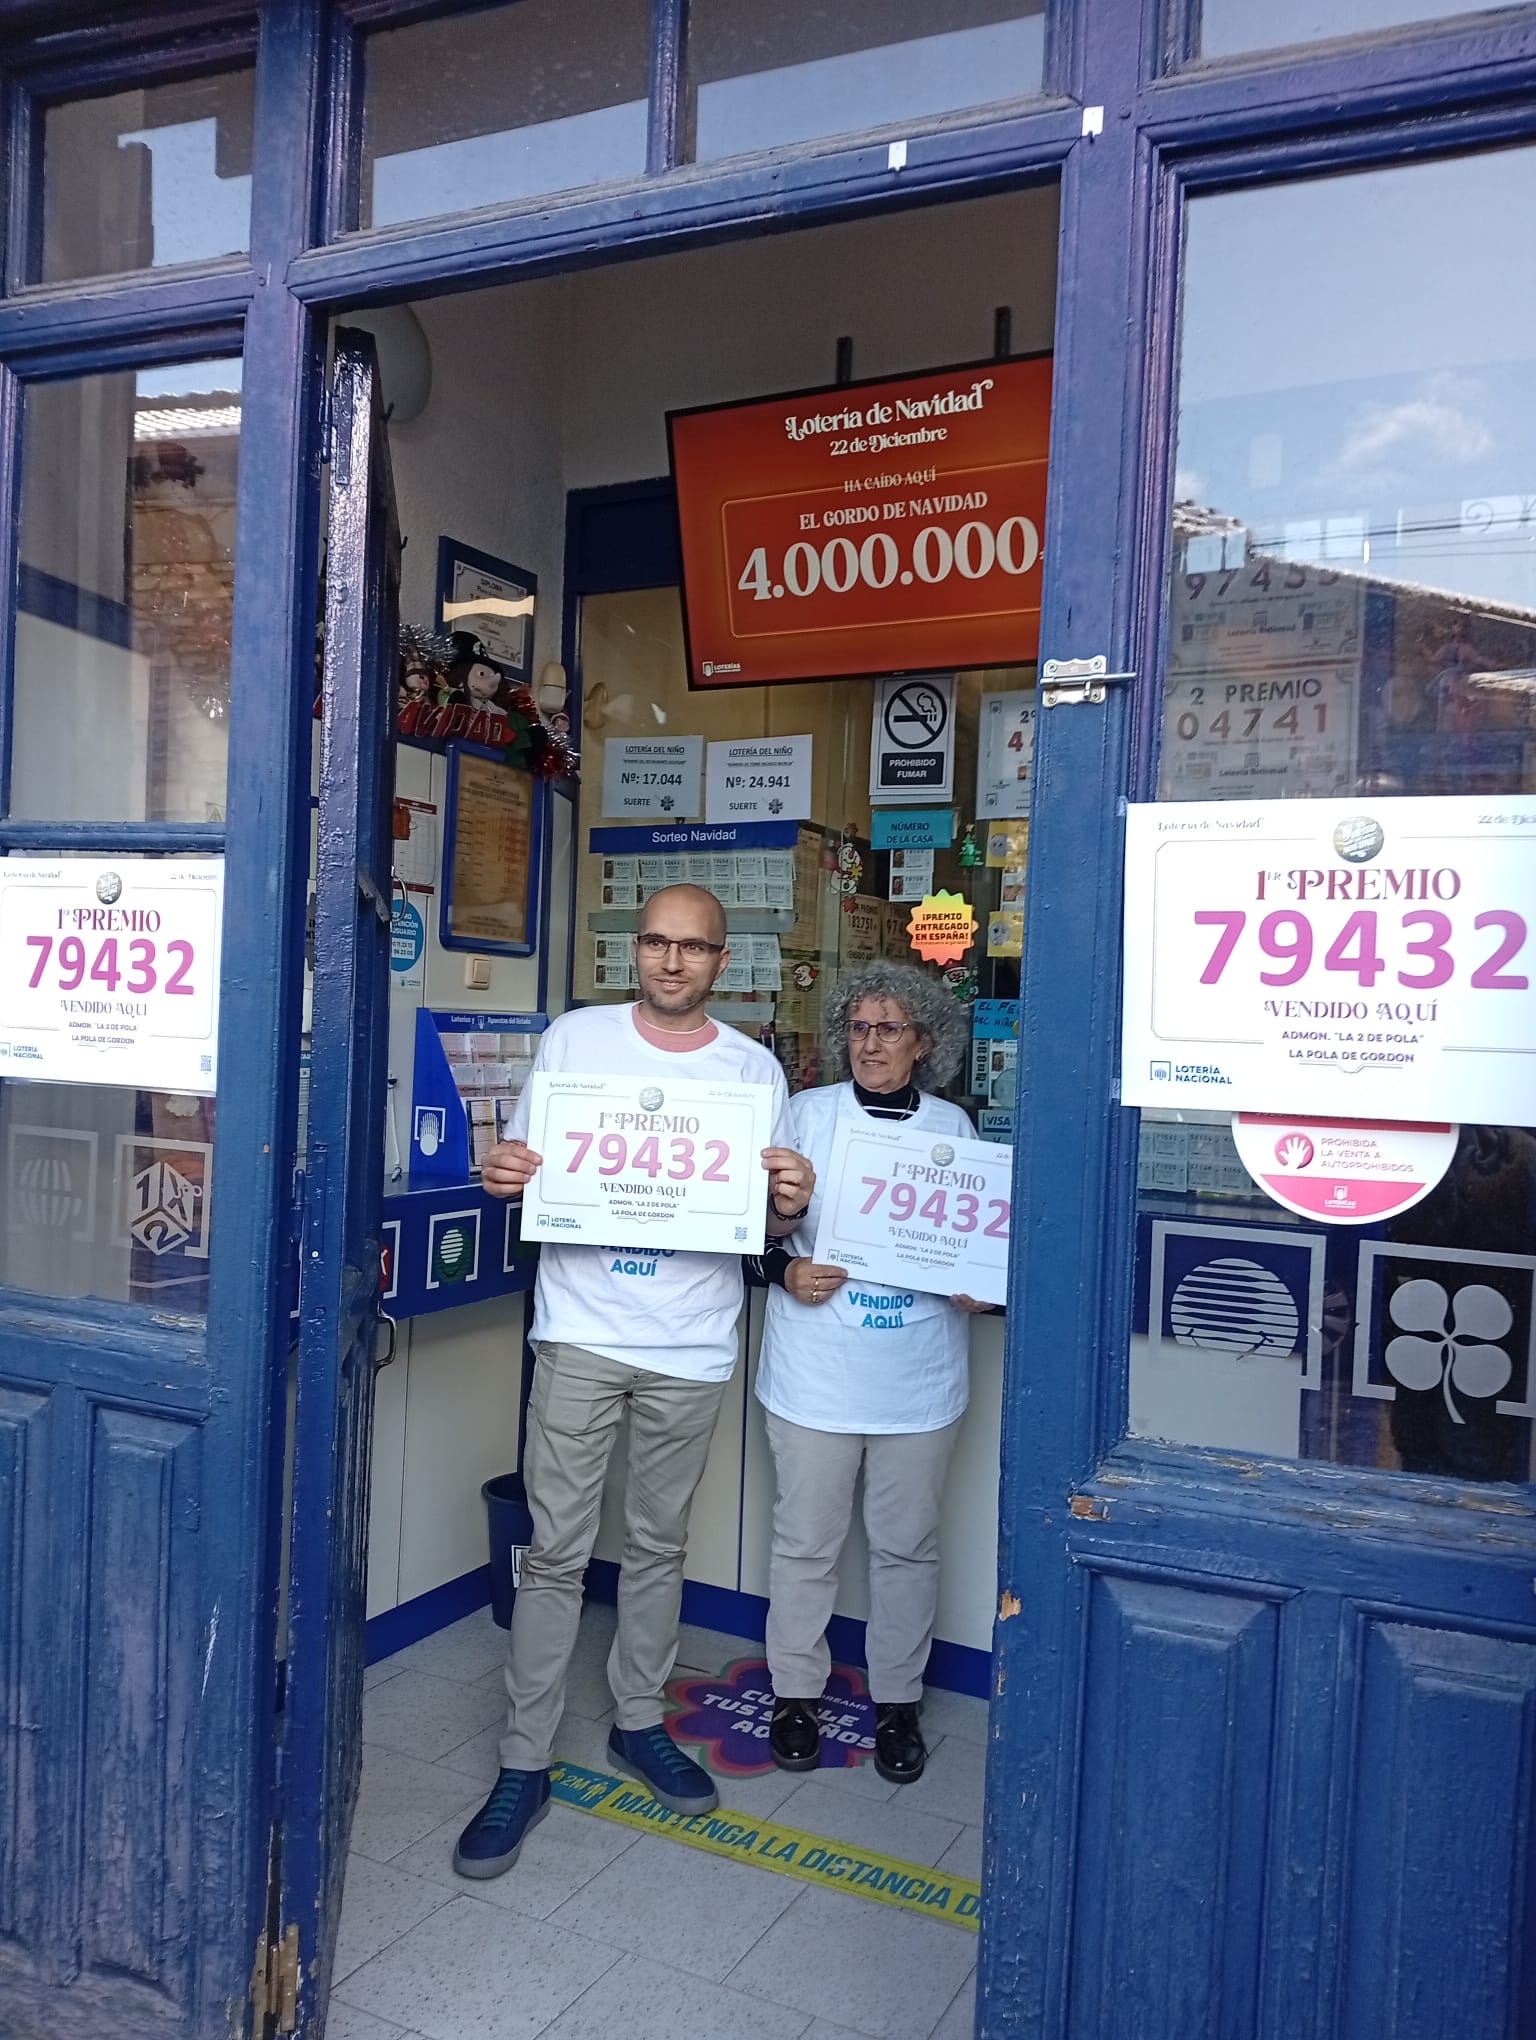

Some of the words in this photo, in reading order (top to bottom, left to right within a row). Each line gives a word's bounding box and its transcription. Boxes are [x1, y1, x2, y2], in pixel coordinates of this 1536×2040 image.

[785, 407, 863, 440] Lotería
[866, 403, 892, 426] de
[895, 379, 994, 421] Navidad
[829, 440, 848, 456] 22
[849, 437, 868, 453] de
[868, 427, 948, 453] Diciembre
[844, 480, 861, 493] HA
[863, 473, 902, 490] CAÍDO
[905, 466, 937, 486] AQUÍ
[800, 514, 820, 530] EL
[823, 505, 880, 527] GORDO
[883, 502, 906, 520] DE
[908, 491, 988, 517] NAVIDAD
[738, 516, 1044, 601] 4.000.000
[1225, 678, 1322, 704] PREMIO
[1177, 703, 1328, 742] 04741
[625, 745, 652, 753] LOTERÍA
[667, 744, 685, 753] NIÑO
[729, 747, 757, 756] LOTERÍA
[760, 747, 772, 755] DEL
[774, 746, 793, 754] NIÑO
[889, 758, 937, 767] PROHIBIDO
[621, 772, 640, 785] Nº:
[643, 773, 682, 785] 17.044
[726, 776, 745, 788] Nº:
[749, 775, 790, 788] 24.941
[897, 770, 927, 778] FUMAR
[624, 797, 651, 806] SUERTE
[729, 802, 758, 811] SUERTE
[891, 821, 929, 832] NÚMERO
[651, 831, 688, 844] Sorteo
[690, 829, 737, 843] Navidad
[887, 835, 897, 844] DE
[900, 836, 910, 844] LA
[912, 835, 933, 843] CASA
[1255, 869, 1282, 900] 1ER
[1287, 868, 1461, 900] PREMIO
[72, 908, 161, 932] PREMIO
[922, 913, 962, 921] ¡PREMIO
[915, 922, 969, 932] ENTREGADO
[929, 930, 969, 941] ESPAÑA!
[1194, 909, 1529, 990] 79432
[27, 936, 195, 995] 79432
[60, 1000, 112, 1013] VENDIDO
[1264, 1000, 1368, 1020] VENDIDO
[1376, 998, 1438, 1025] AQUÍ
[1282, 1031, 1331, 1041] ADMON.
[1357, 1033, 1364, 1042] 2
[1367, 1033, 1382, 1043] DE
[1289, 1049, 1303, 1058] LA
[1307, 1050, 1339, 1060] POLA
[1342, 1051, 1358, 1061] DE
[1360, 1052, 1415, 1063] GORDON
[1175, 1064, 1221, 1075] LOTERÍA
[1175, 1074, 1232, 1085] NACIONAL
[615, 1113, 700, 1134] PREMIO
[987, 1116, 1011, 1126] VISA
[1321, 1138, 1378, 1148] PROHIBIDA
[565, 1132, 731, 1182] 79432
[1337, 1150, 1370, 1159] VENTA
[1321, 1160, 1414, 1173] AUTOPROHIBIDOS
[907, 1163, 986, 1192] PREMIO
[600, 1182, 653, 1195] VENDIDO
[656, 1184, 687, 1198] AQUÍ
[859, 1176, 1011, 1239] 79432
[889, 1226, 937, 1244] VENDIDO
[939, 1236, 968, 1249] AQUÍ
[610, 1259, 658, 1277] AQUÍ
[848, 1290, 914, 1310] VENDIDO
[861, 1311, 904, 1329] AQUÍ
[702, 1694, 758, 1717] TUS
[757, 1835, 798, 1862] LA
[798, 1847, 952, 1912] DISTANCIA
[954, 1893, 982, 1921] D
